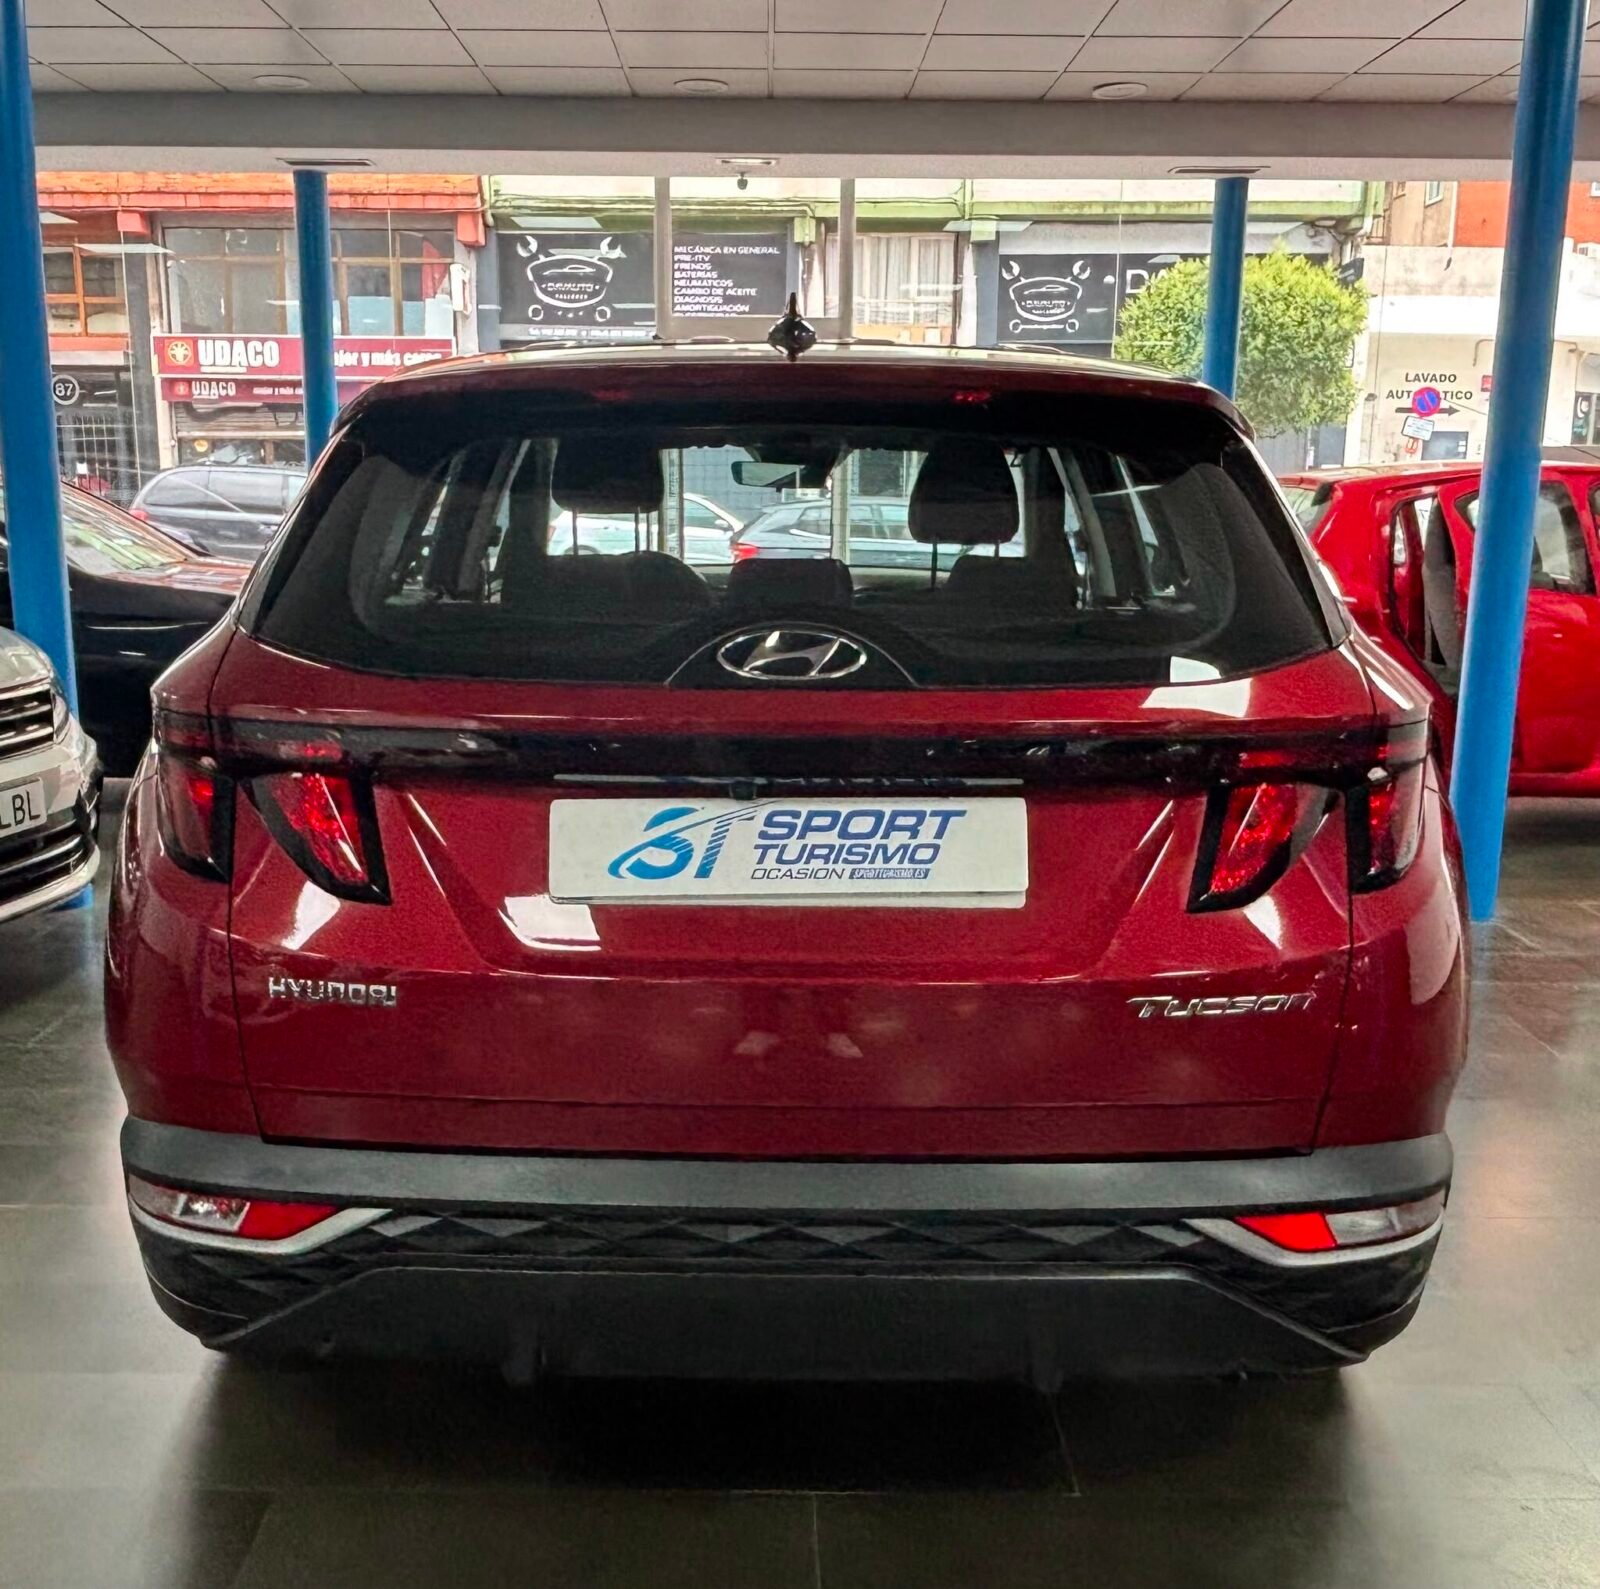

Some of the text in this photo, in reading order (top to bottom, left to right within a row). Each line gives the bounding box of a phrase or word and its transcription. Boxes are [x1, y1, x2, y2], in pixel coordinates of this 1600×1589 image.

[723, 246, 736, 254] EN
[738, 246, 780, 254] GENERAL
[725, 288, 758, 296] ACEITE
[197, 340, 280, 367] UDACO
[1405, 372, 1457, 383] LAVADO
[55, 383, 73, 396] 87
[192, 381, 236, 396] UDACO
[1386, 390, 1473, 400] AUTTICO
[758, 810, 967, 840] SPORT
[752, 844, 942, 865] TURISMO
[751, 868, 845, 880] OCASION
[268, 977, 397, 1006] HYUNDAI
